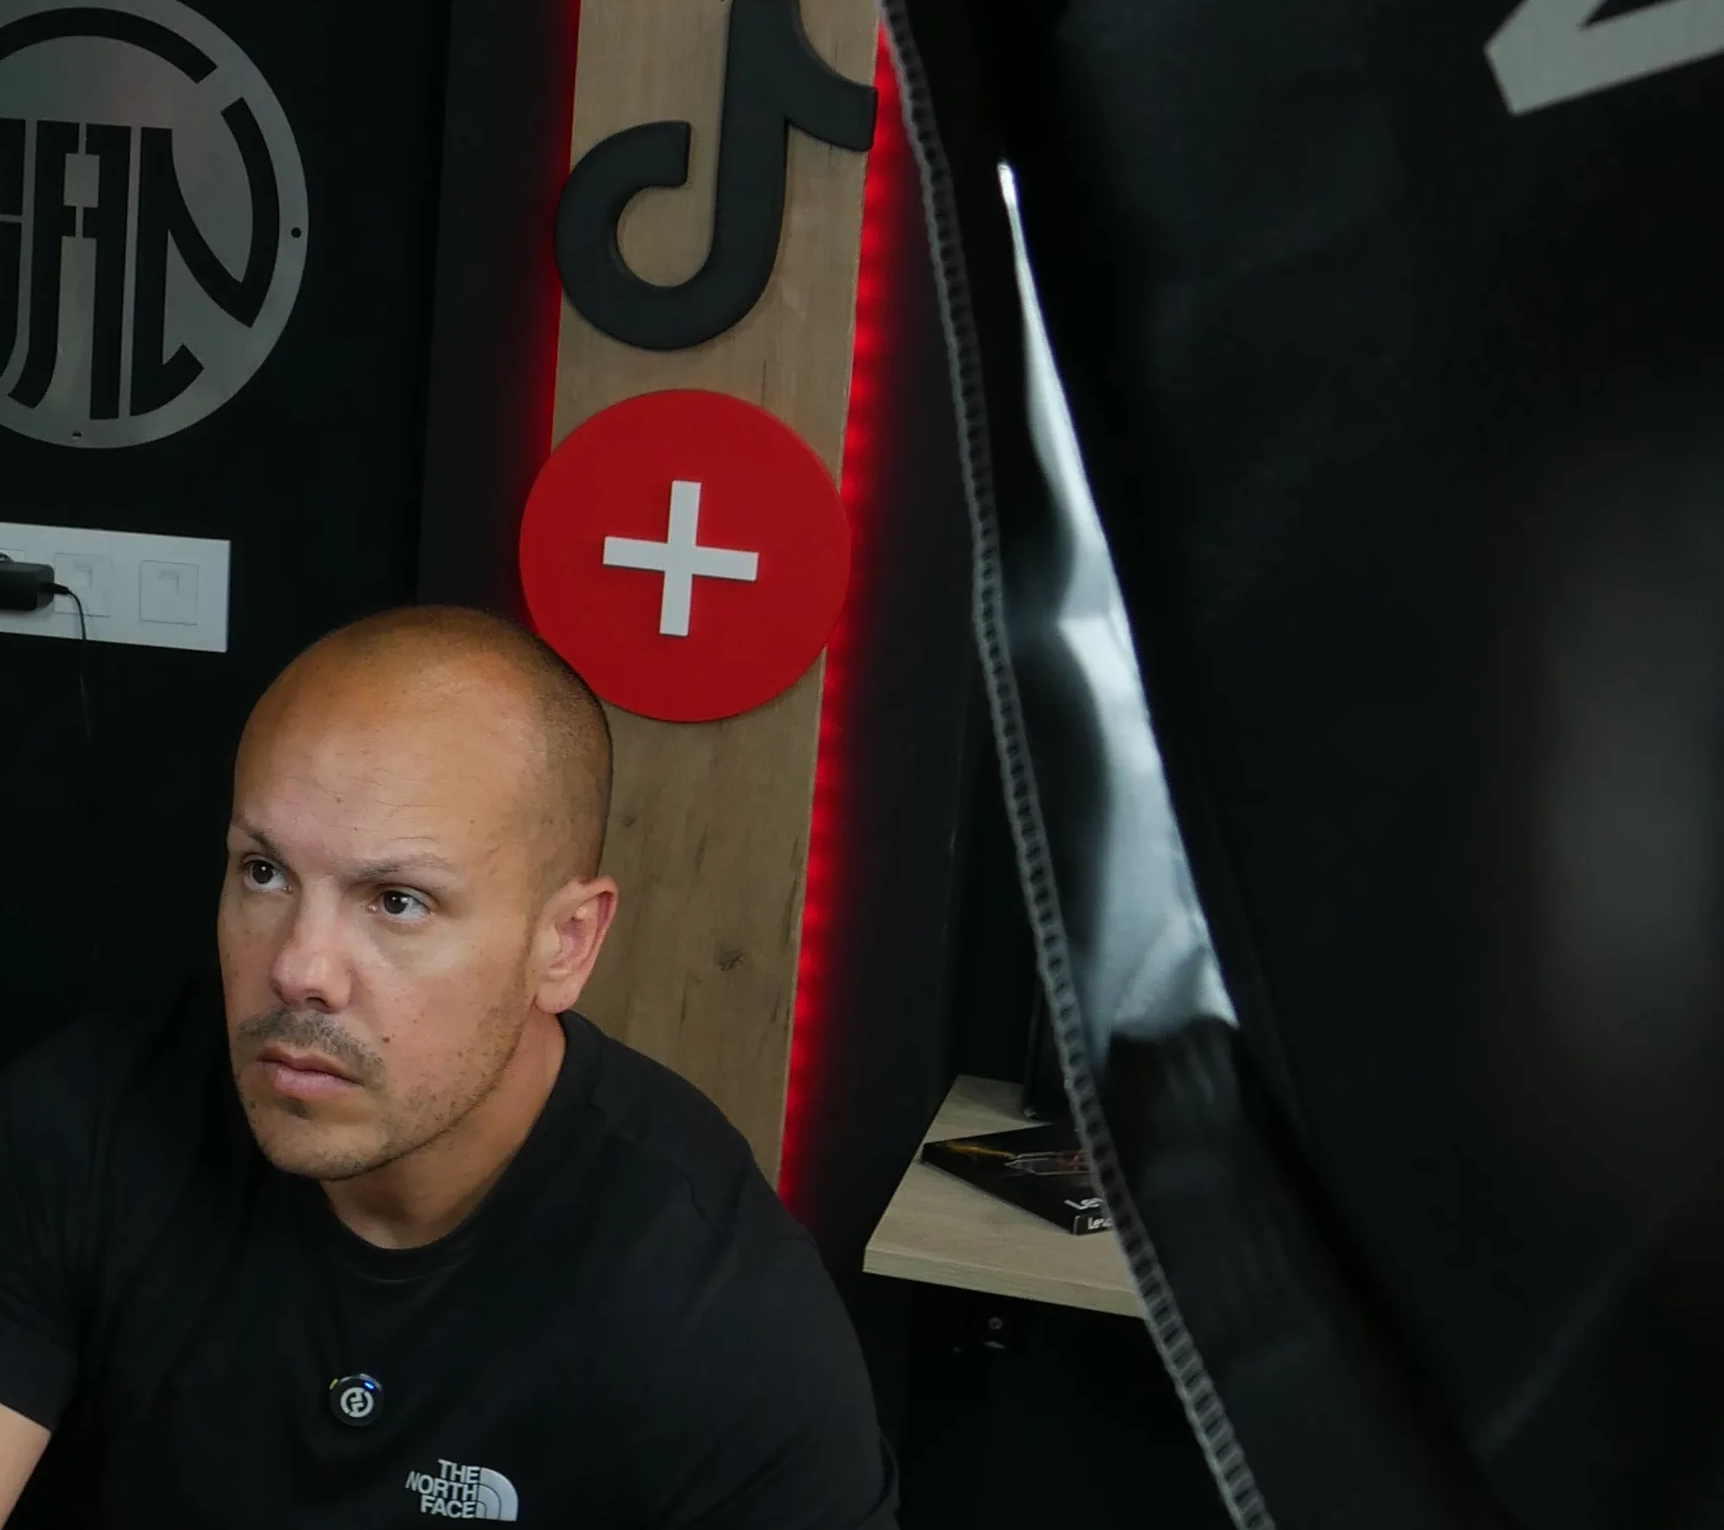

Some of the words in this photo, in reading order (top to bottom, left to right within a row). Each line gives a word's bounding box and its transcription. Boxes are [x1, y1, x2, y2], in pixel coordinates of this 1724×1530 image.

[438, 1458, 481, 1484] THE
[405, 1470, 478, 1502] NORTH
[420, 1494, 477, 1519] FACE
